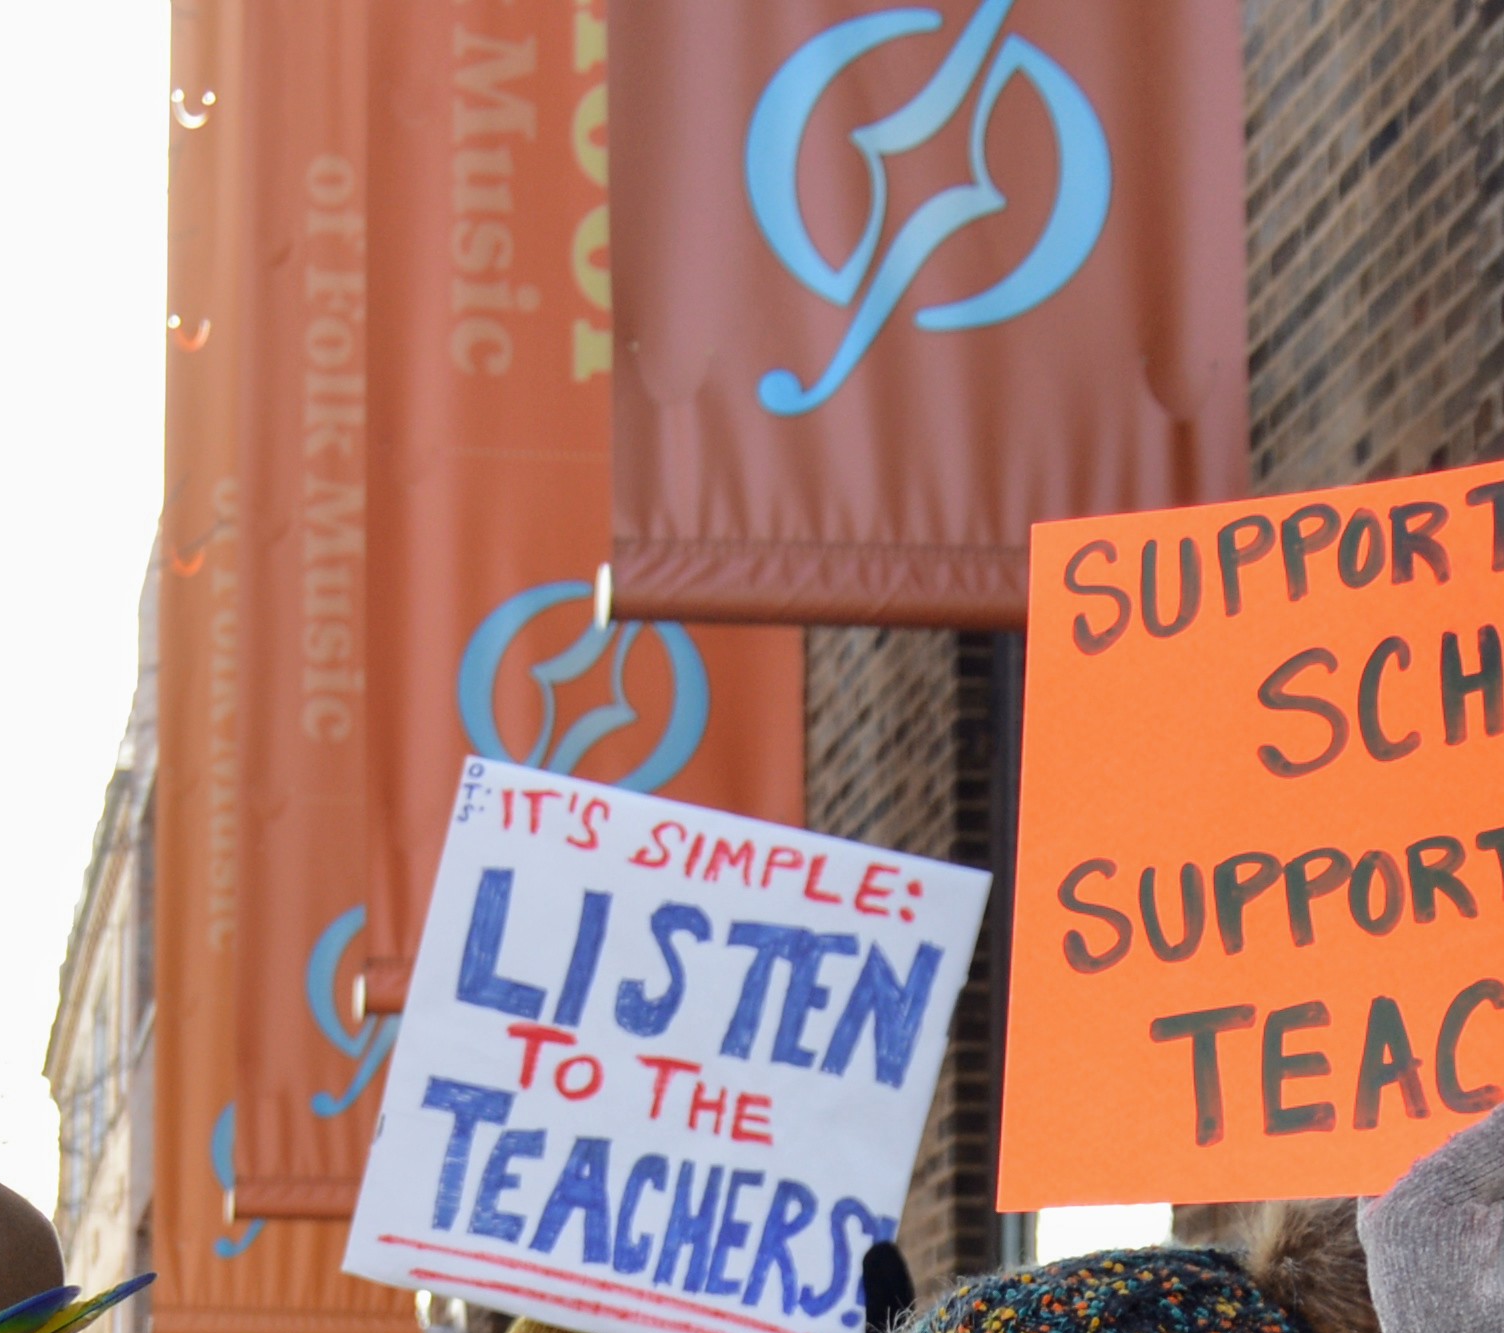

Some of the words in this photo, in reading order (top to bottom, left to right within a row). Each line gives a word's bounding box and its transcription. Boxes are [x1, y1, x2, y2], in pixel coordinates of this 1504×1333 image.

[450, 23, 542, 377] Music
[302, 264, 367, 458] Folk
[301, 470, 367, 743] Music
[501, 788, 611, 851] IT'S
[630, 821, 924, 924] SIMPLE:
[455, 866, 945, 1091] LISTEN
[507, 1023, 604, 1102] TO
[638, 1055, 773, 1145] THE
